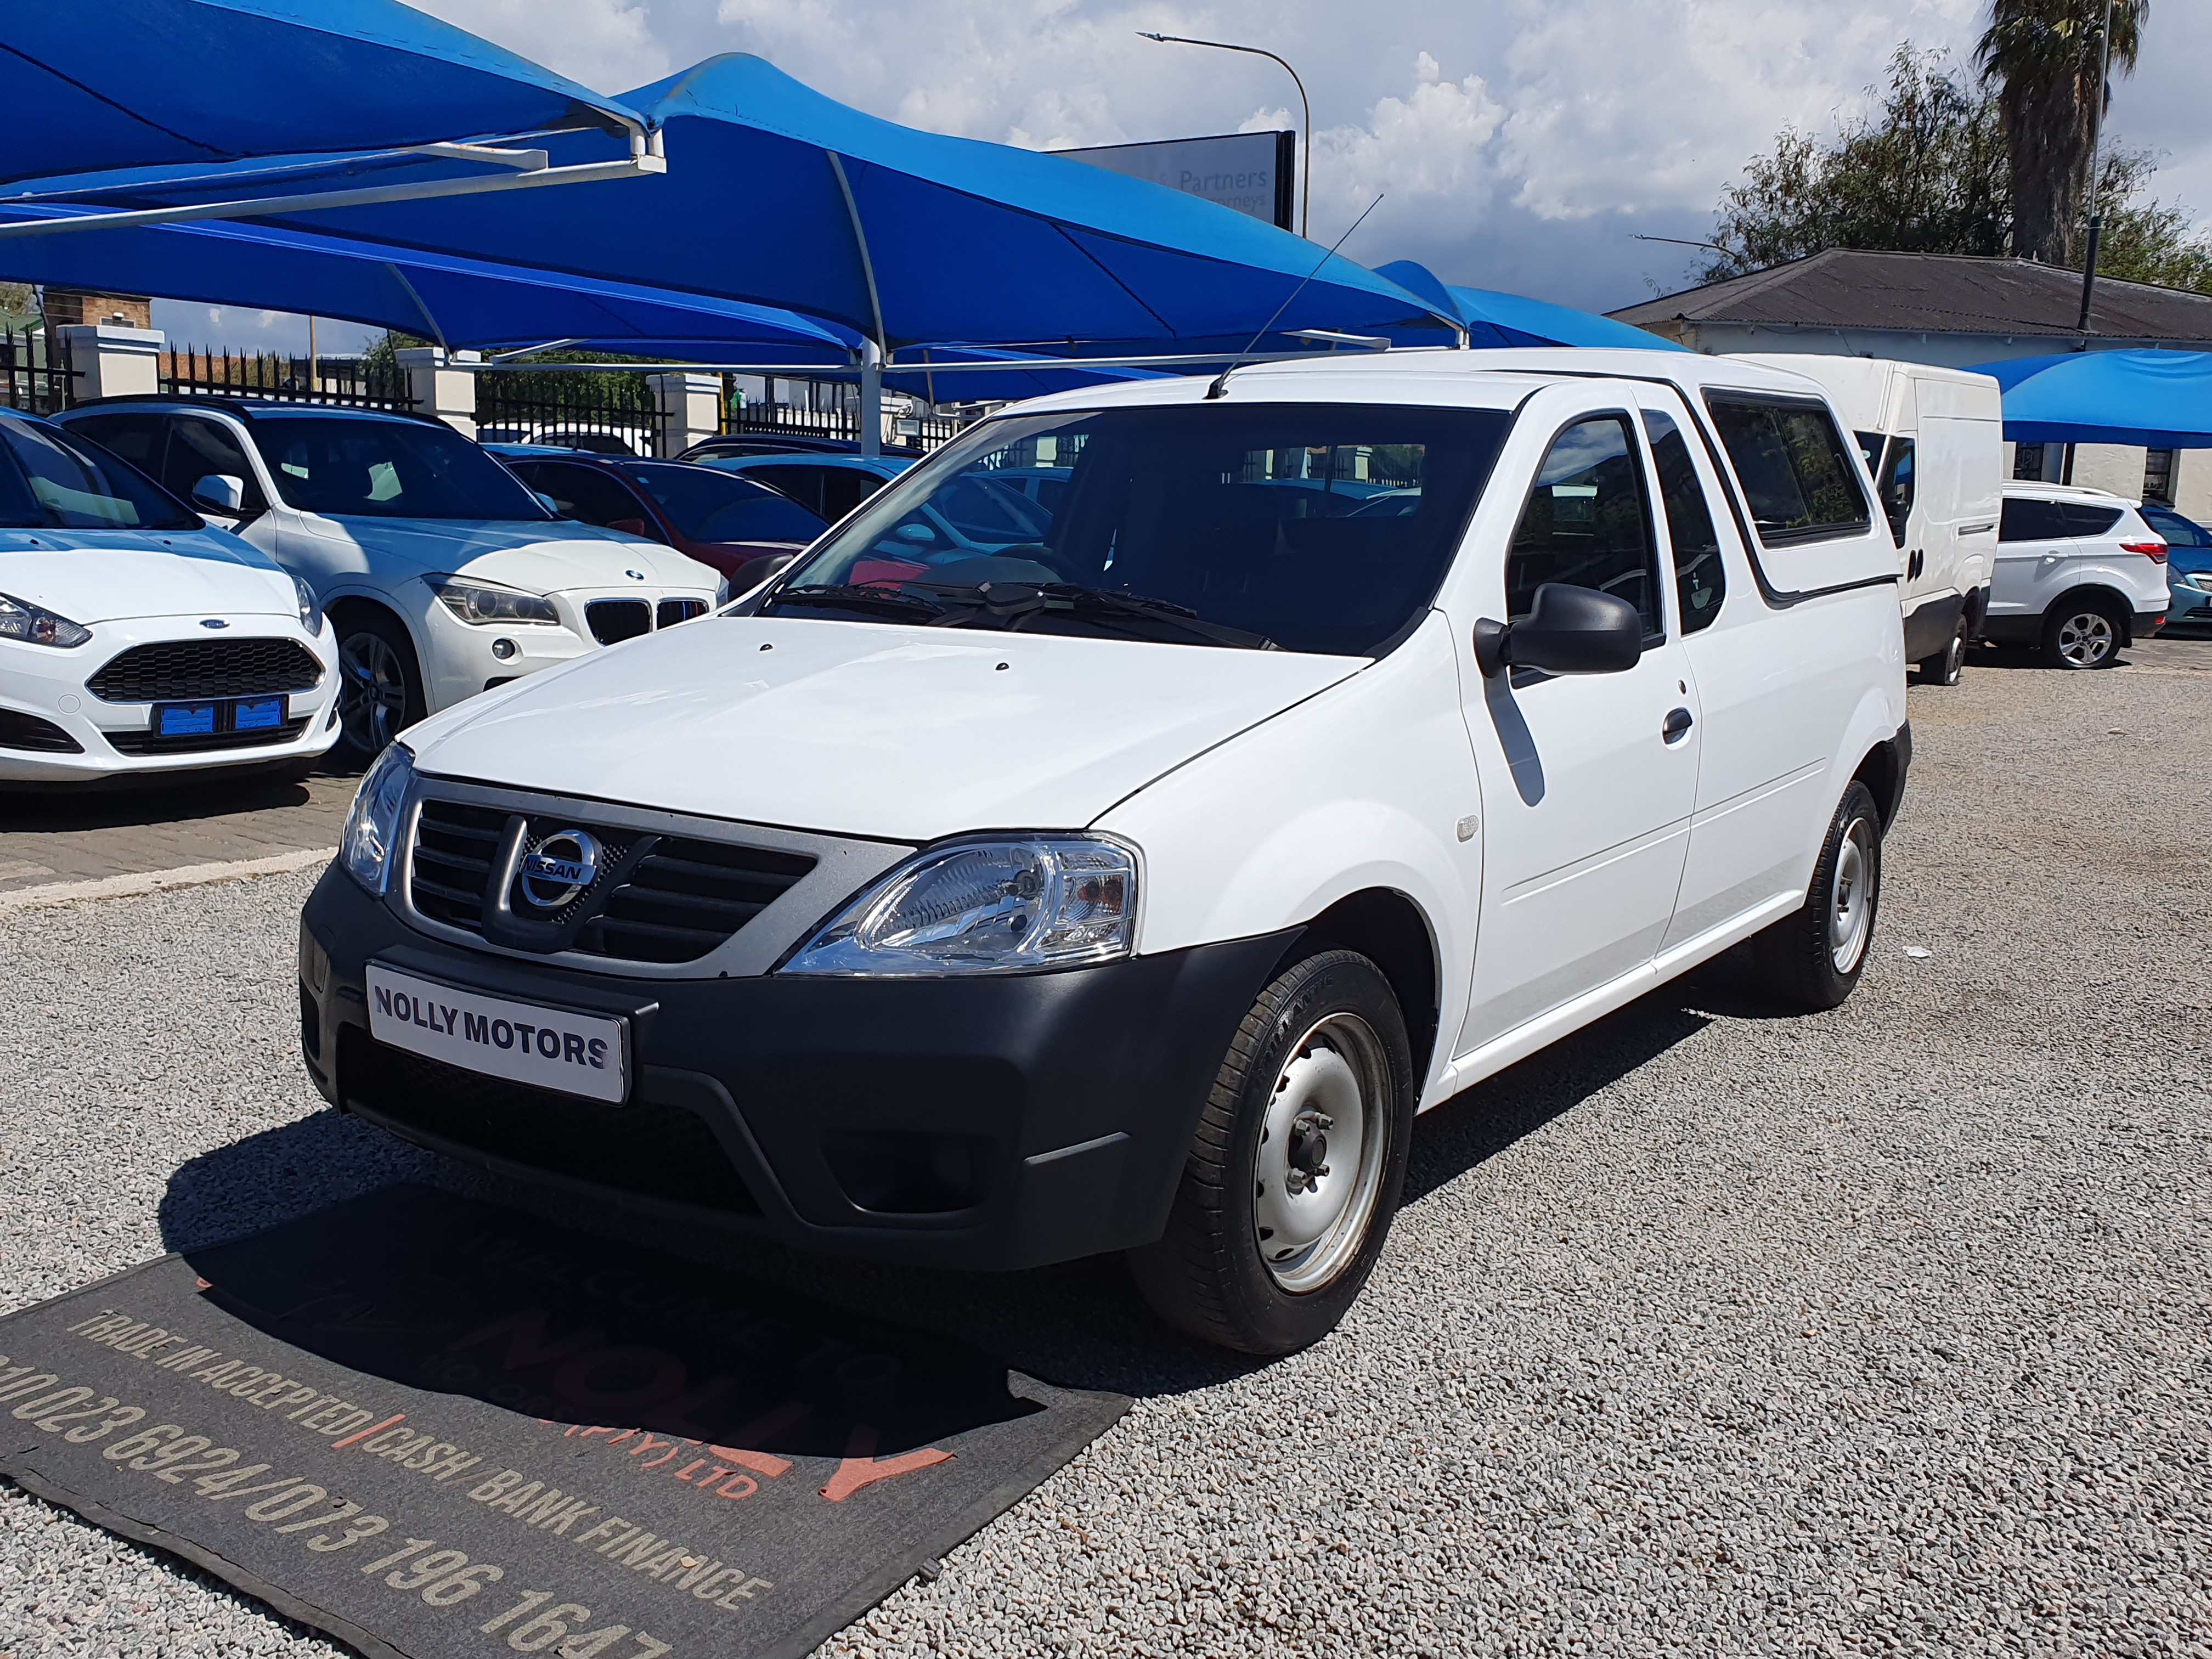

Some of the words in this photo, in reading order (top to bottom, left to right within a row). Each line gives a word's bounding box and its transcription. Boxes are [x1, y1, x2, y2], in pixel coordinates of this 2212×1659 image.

[1181, 170, 1267, 191] Partners
[1208, 195, 1266, 213] orneys
[523, 859, 582, 880] NISSAN
[374, 985, 459, 1036] NOLLY
[464, 1011, 608, 1069] MOTORS
[445, 1306, 957, 1502] NOLLY
[0, 1355, 59, 1402] 10
[360, 1537, 504, 1606] 196
[66, 1309, 188, 1359] TRADE
[155, 1345, 222, 1372] IN
[189, 1359, 374, 1436] ACCEPTED
[363, 1427, 483, 1481] CASH
[467, 1469, 601, 1535] BANK
[573, 1516, 774, 1611] FINANCE
[674, 1458, 759, 1500] LTD
